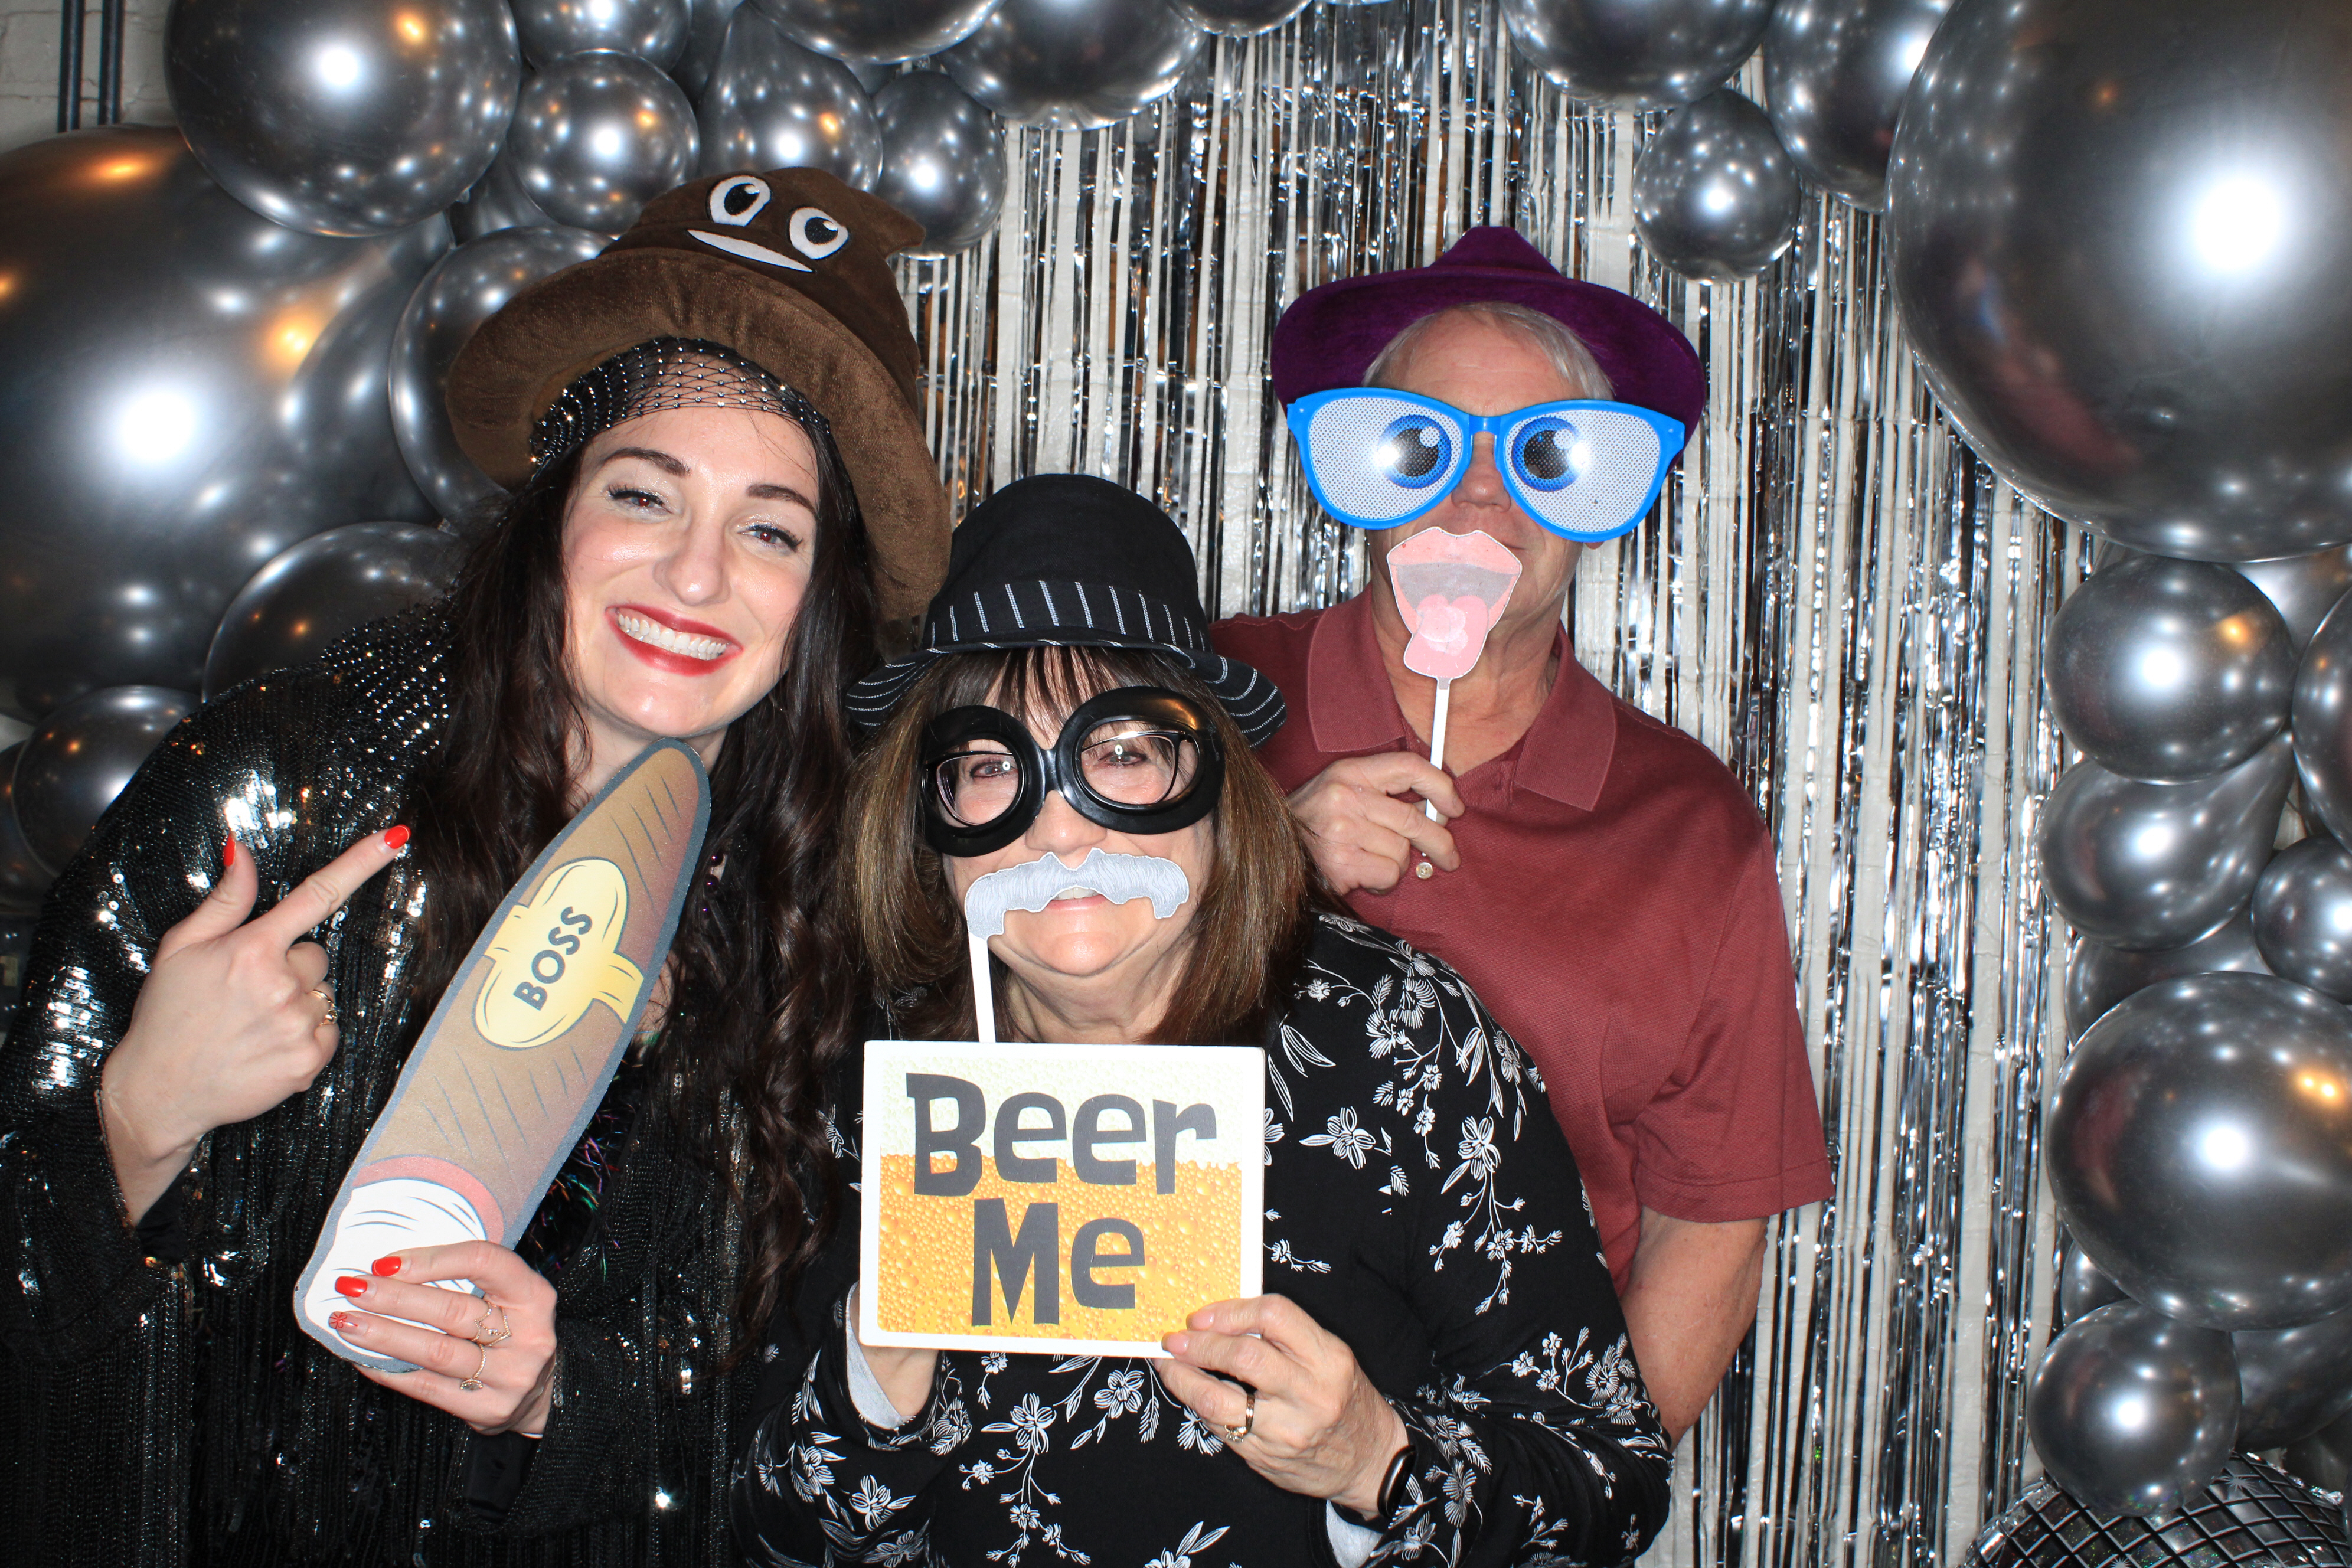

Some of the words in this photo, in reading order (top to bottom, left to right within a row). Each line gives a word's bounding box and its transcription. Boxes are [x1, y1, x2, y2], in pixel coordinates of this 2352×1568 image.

[513, 906, 592, 1011] BOSS
[906, 1073, 1217, 1197] Beer
[971, 1198, 1145, 1327] Me
